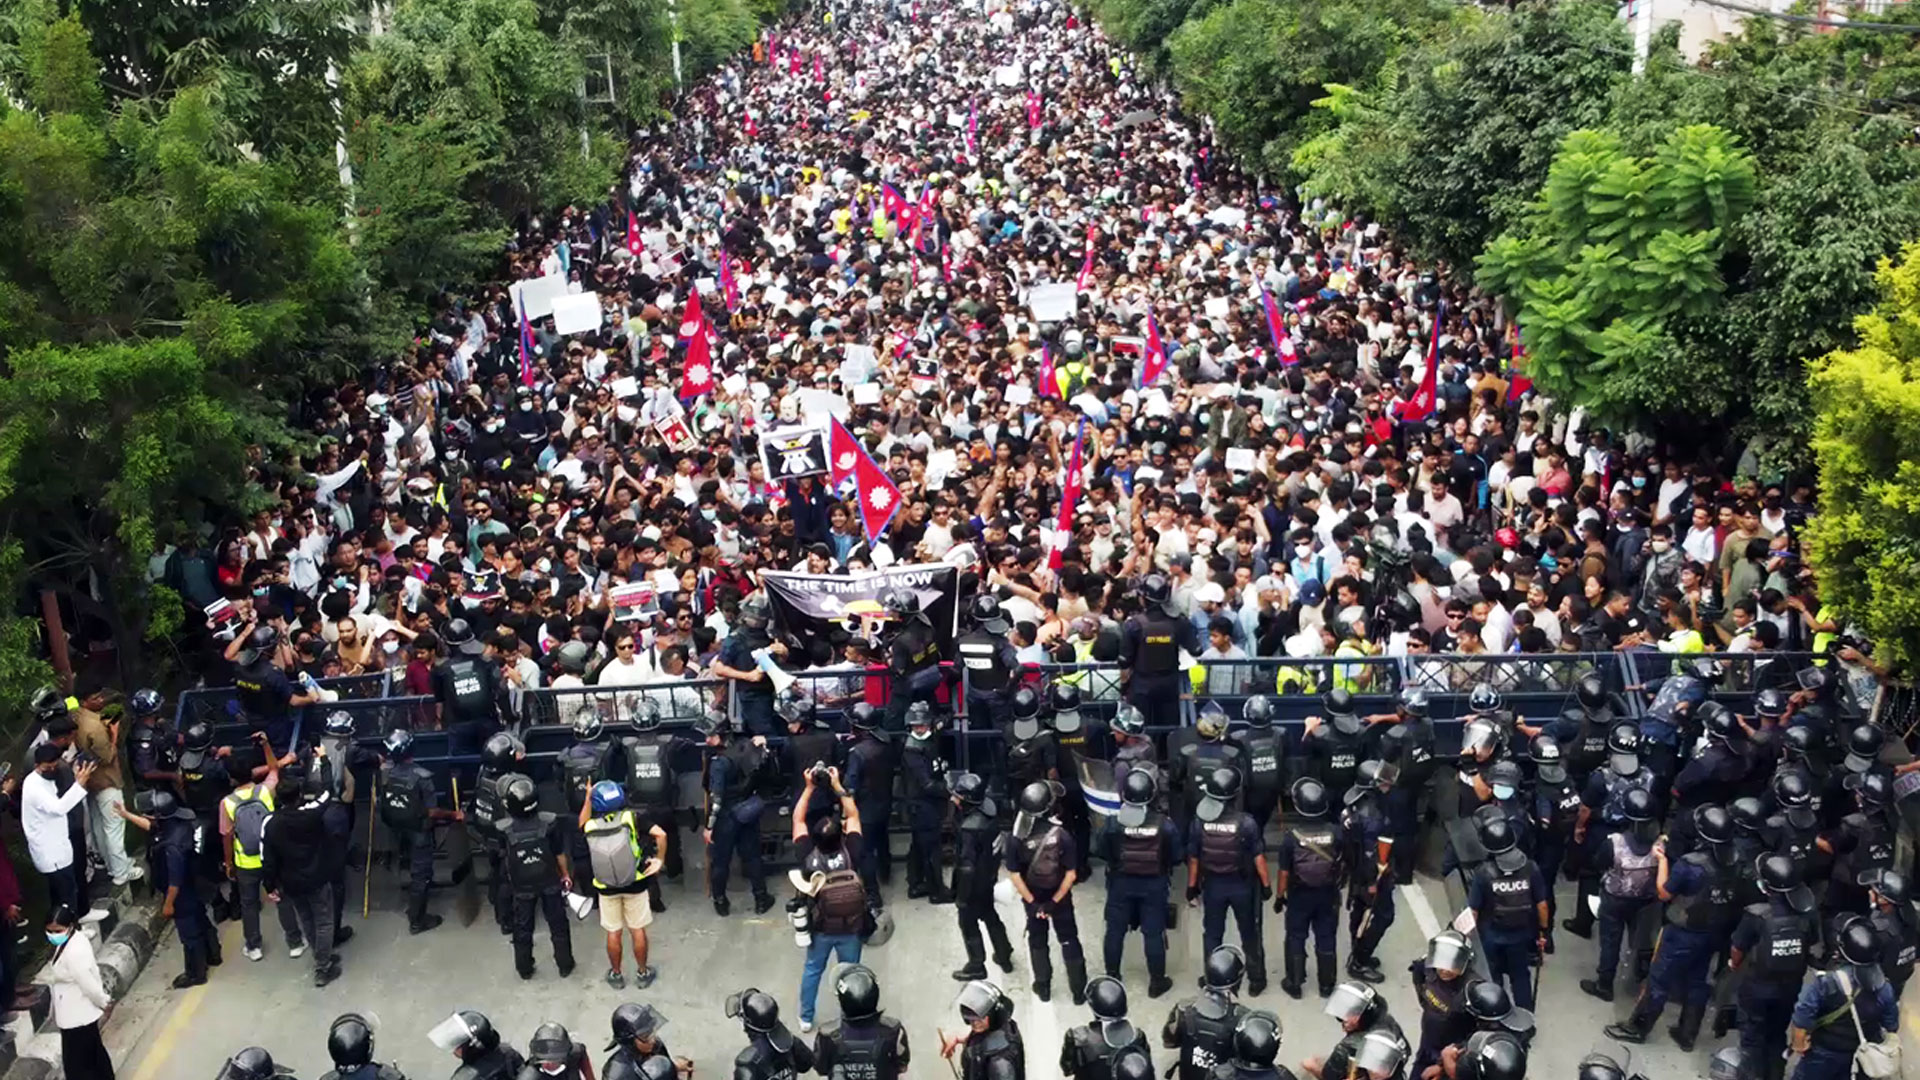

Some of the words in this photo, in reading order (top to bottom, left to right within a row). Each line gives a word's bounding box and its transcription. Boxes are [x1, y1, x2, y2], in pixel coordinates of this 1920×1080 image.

[783, 578, 819, 592] THE
[822, 579, 867, 593] TIME
[869, 577, 887, 590] IS
[888, 571, 934, 588] NOW
[454, 677, 480, 689] NEPAL
[456, 683, 480, 695] POLICE
[1251, 756, 1276, 764] NEPAL
[1252, 762, 1277, 772] POLICE
[636, 770, 660, 778] POLICE
[1492, 879, 1529, 892] POLICE
[1772, 939, 1802, 948] NEPAL
[1771, 947, 1802, 957] POLICE
[845, 1063, 877, 1072] NEPAL
